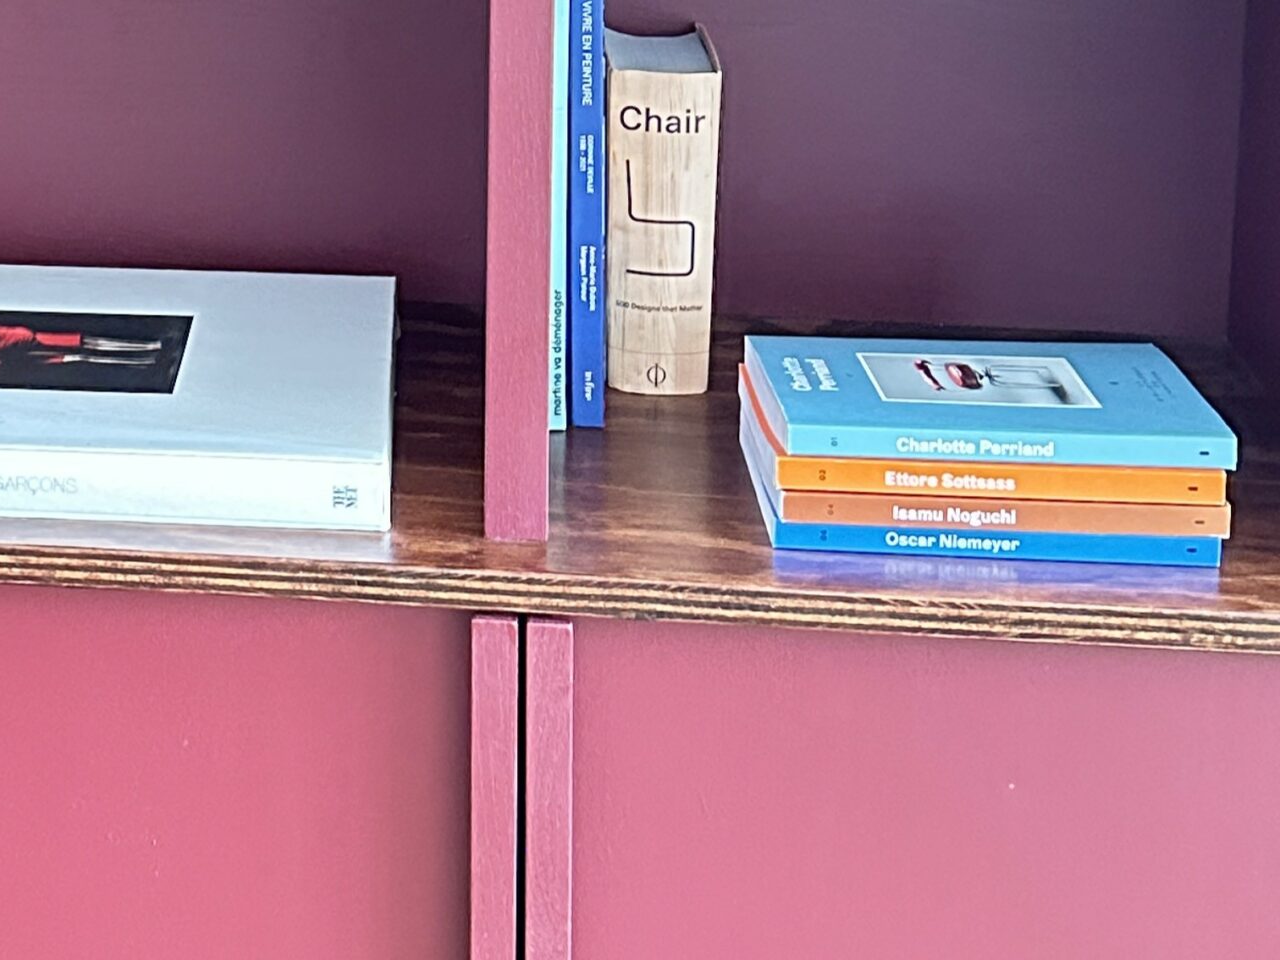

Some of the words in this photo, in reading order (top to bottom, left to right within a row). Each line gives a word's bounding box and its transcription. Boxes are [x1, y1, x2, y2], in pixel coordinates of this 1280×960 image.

[581, 0, 592, 33] VIVRE
[581, 35, 592, 51] EN
[581, 52, 593, 106] PEINTURE
[619, 106, 706, 134] Chair
[631, 301, 661, 312] Designs
[662, 302, 677, 312] that
[678, 303, 704, 312] Matter
[552, 289, 564, 353] déménager
[553, 356, 562, 370] va
[553, 372, 562, 417] martine
[895, 436, 977, 454] Charlotte
[979, 438, 1056, 458] Perriand
[884, 470, 939, 488] Ettore
[940, 473, 1017, 492] Sottsass
[892, 505, 945, 522] Isamu
[947, 507, 1017, 527] Noguchi
[884, 531, 937, 548] Oscar
[938, 534, 1021, 554] Niemeyer
